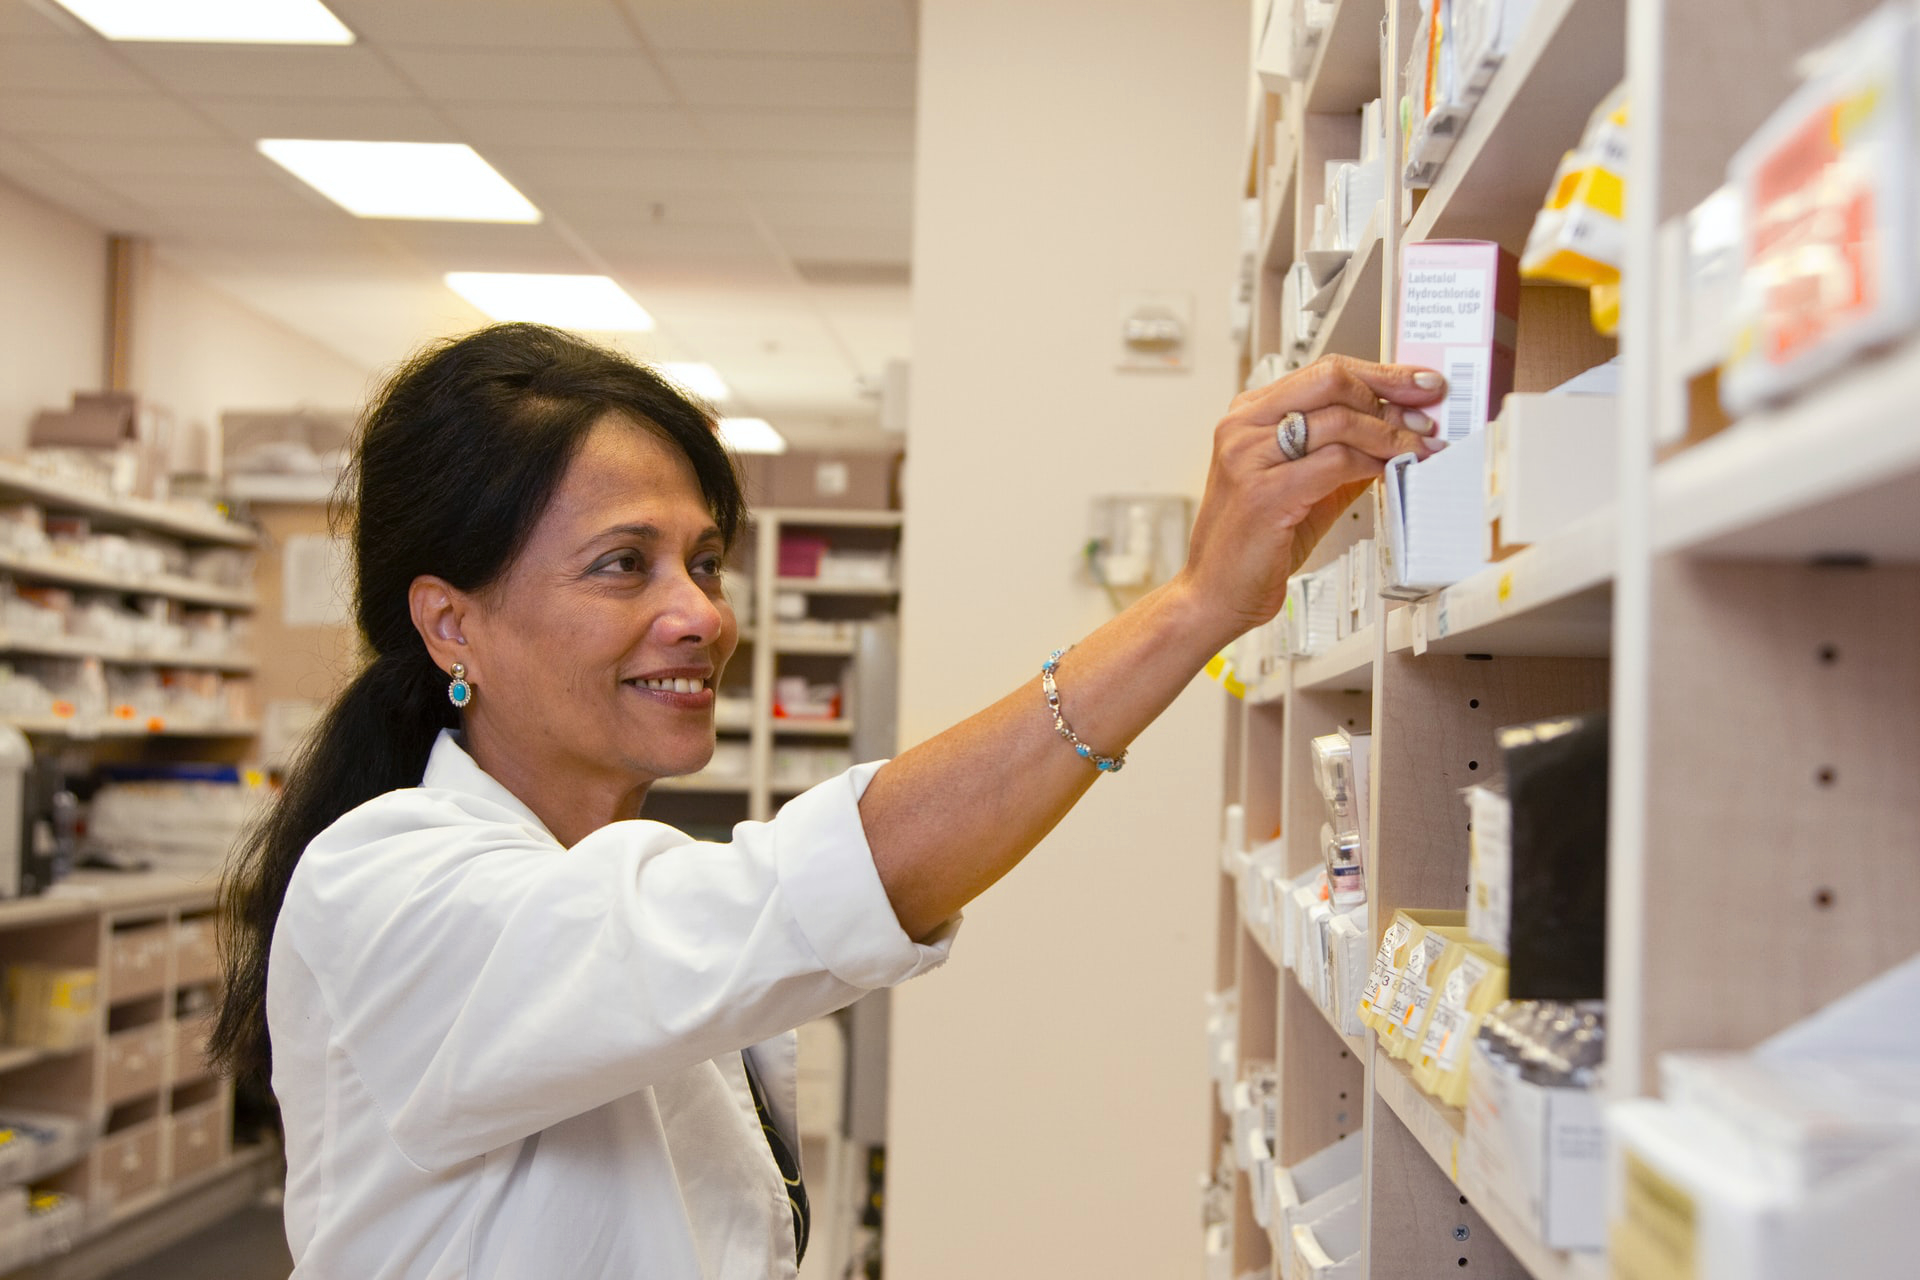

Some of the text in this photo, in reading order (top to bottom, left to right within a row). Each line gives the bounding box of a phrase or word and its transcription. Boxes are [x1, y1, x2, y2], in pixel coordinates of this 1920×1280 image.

[1408, 271, 1456, 283] Labetalol
[1408, 287, 1481, 301] Hydrochloride
[1407, 302, 1481, 316] Injection, USP
